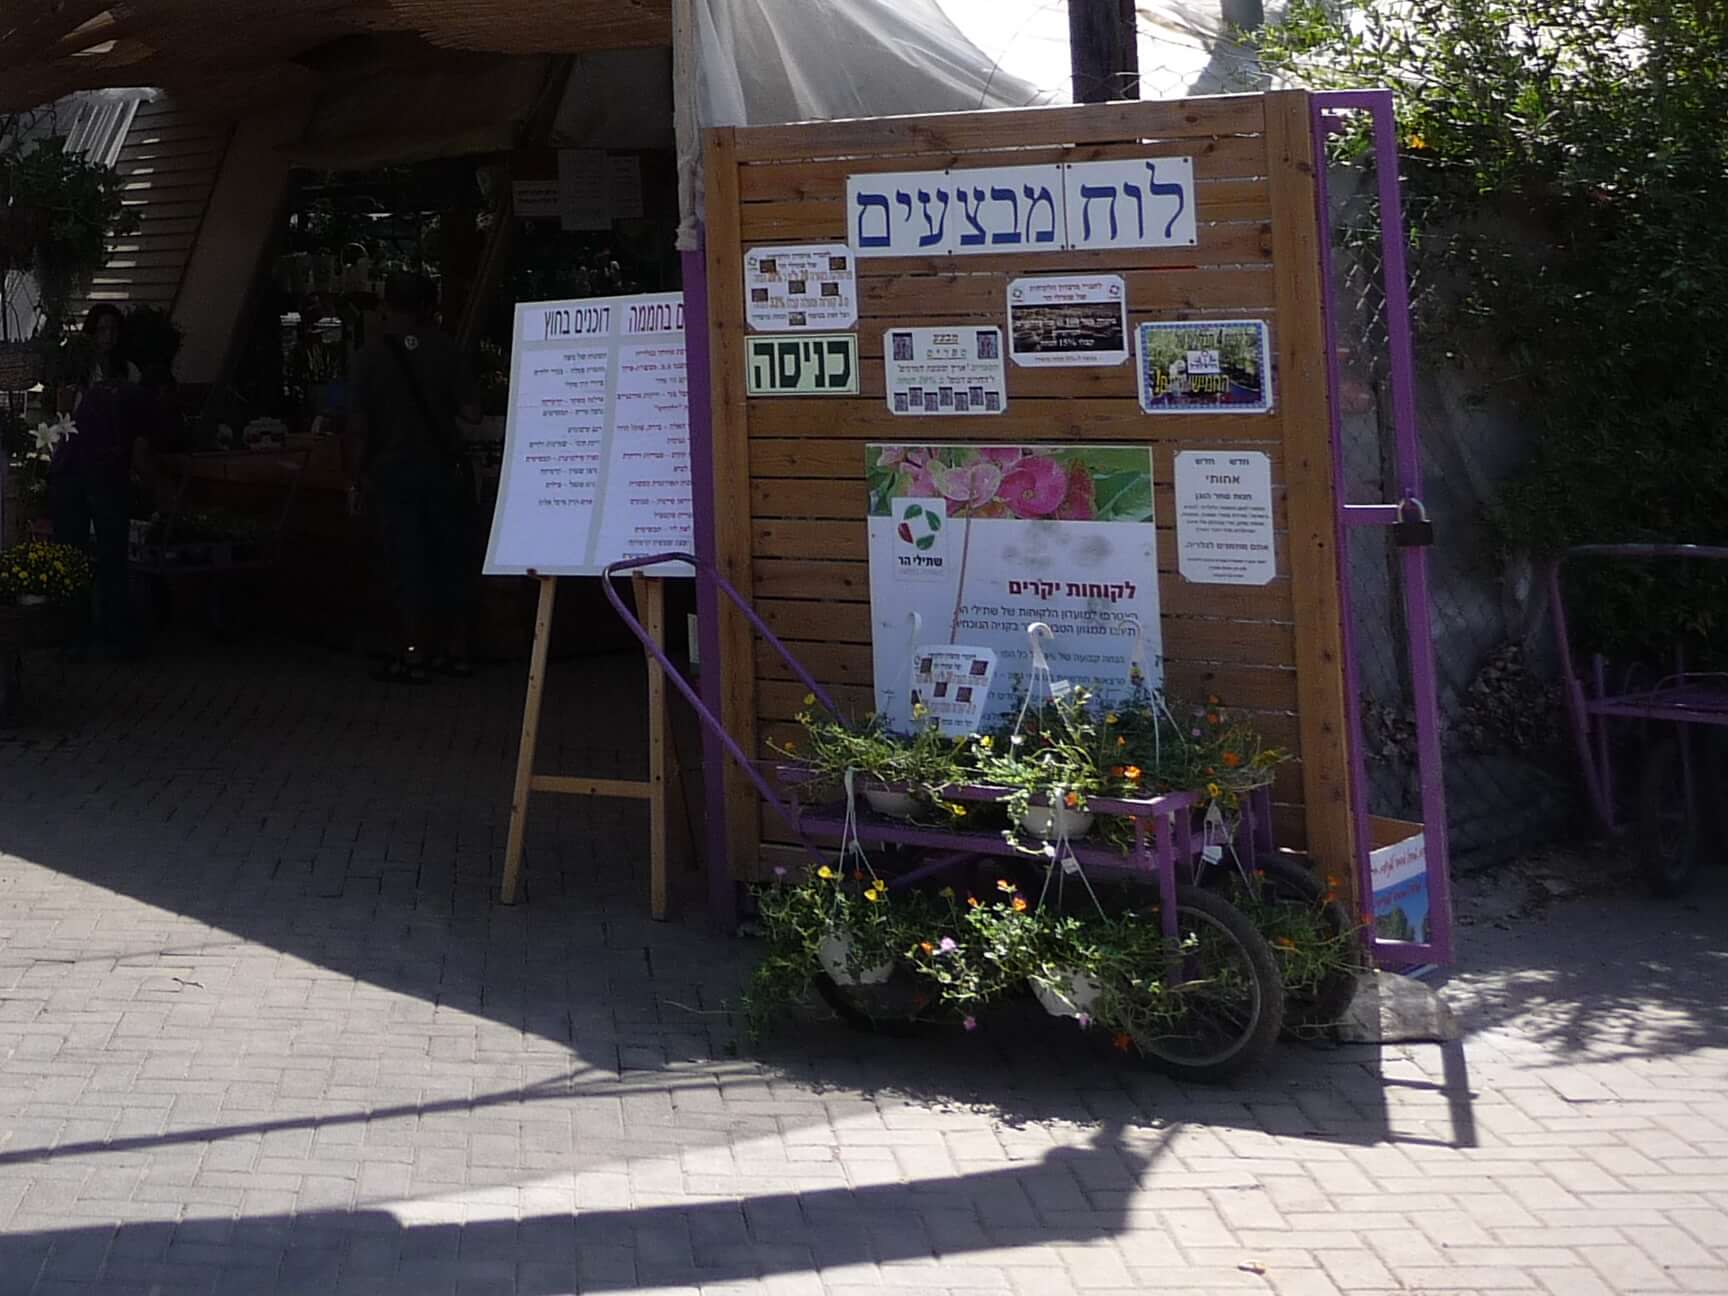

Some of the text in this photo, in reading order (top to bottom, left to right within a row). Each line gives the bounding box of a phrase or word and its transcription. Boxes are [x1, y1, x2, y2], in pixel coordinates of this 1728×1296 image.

[856, 161, 1186, 248] לוח מבצעים
[544, 307, 610, 342] דוכנים בחוץ
[628, 305, 672, 333] בחממה
[753, 340, 851, 389] כניסה
[897, 553, 943, 567] שתילי הר
[1008, 579, 1137, 603] לקוחות יקרים
[1001, 605, 1015, 617] של
